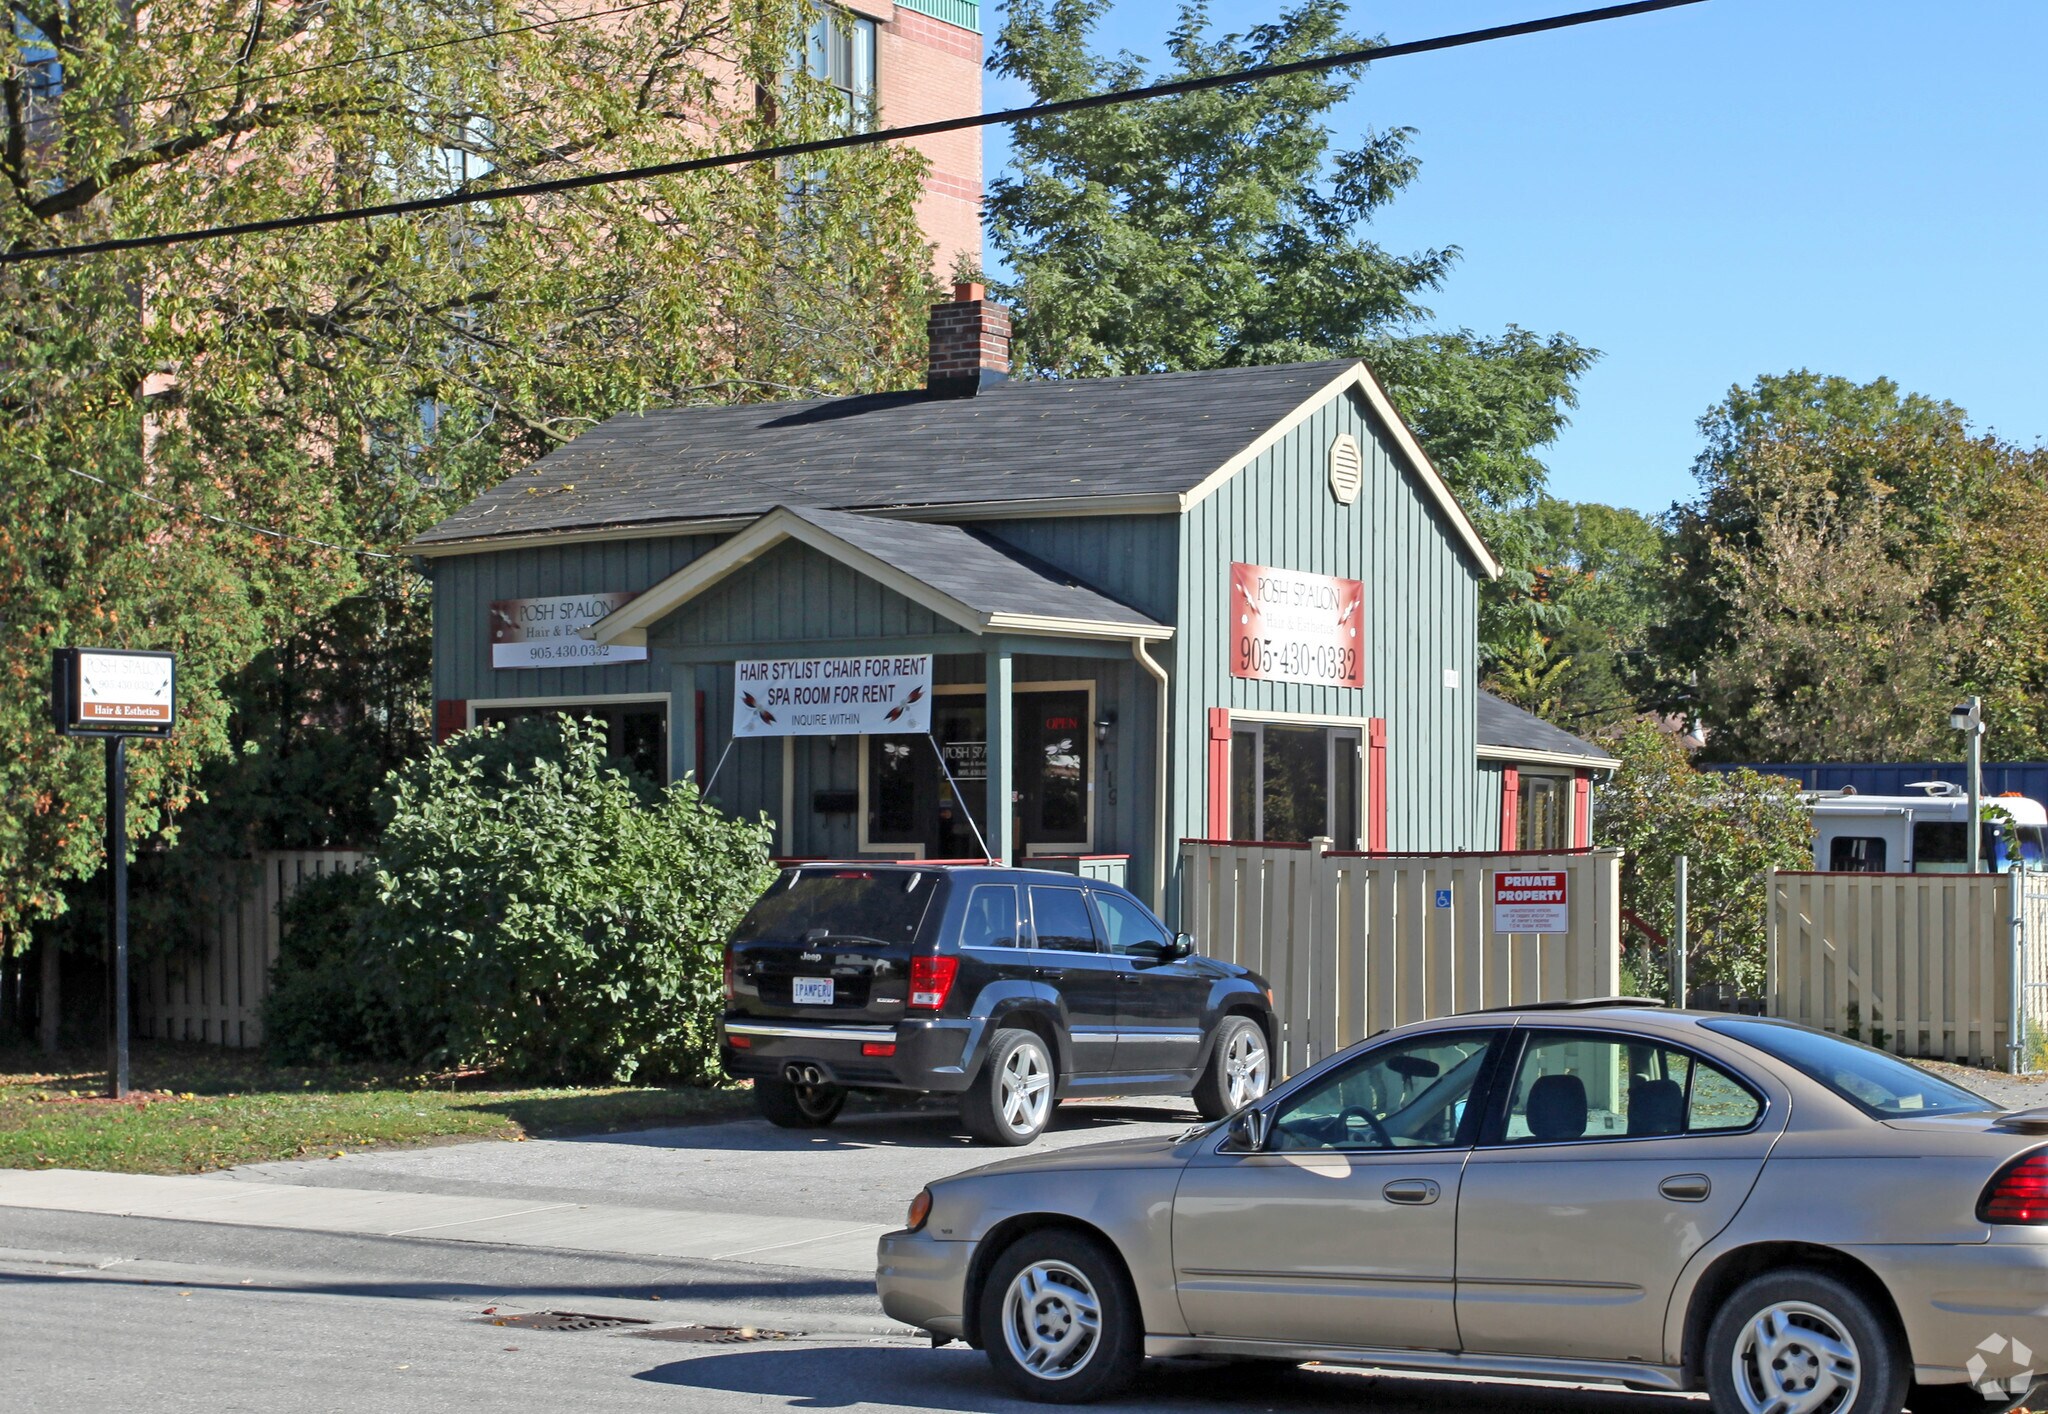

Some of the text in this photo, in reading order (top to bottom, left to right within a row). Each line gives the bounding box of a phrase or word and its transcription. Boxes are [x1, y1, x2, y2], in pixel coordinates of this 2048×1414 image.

[1257, 577, 1341, 611] POSH SPALON
[519, 600, 614, 622] POSH SPALON
[526, 627, 550, 638] Hair
[552, 626, 562, 636] &
[530, 645, 610, 660] 905.430.0332
[740, 657, 927, 681] HAIR STYLIST CHAIR FOR RENT
[768, 684, 896, 706] SPA ROOM FOR RENT
[95, 705, 160, 716] Hair & Esthetics
[792, 713, 860, 726] INQUIRE WITHIN
[1045, 717, 1078, 730] OPEN
[1504, 876, 1556, 887] PRIVATE
[1498, 890, 1563, 901] PROPERTY
[800, 951, 822, 963] Jeep
